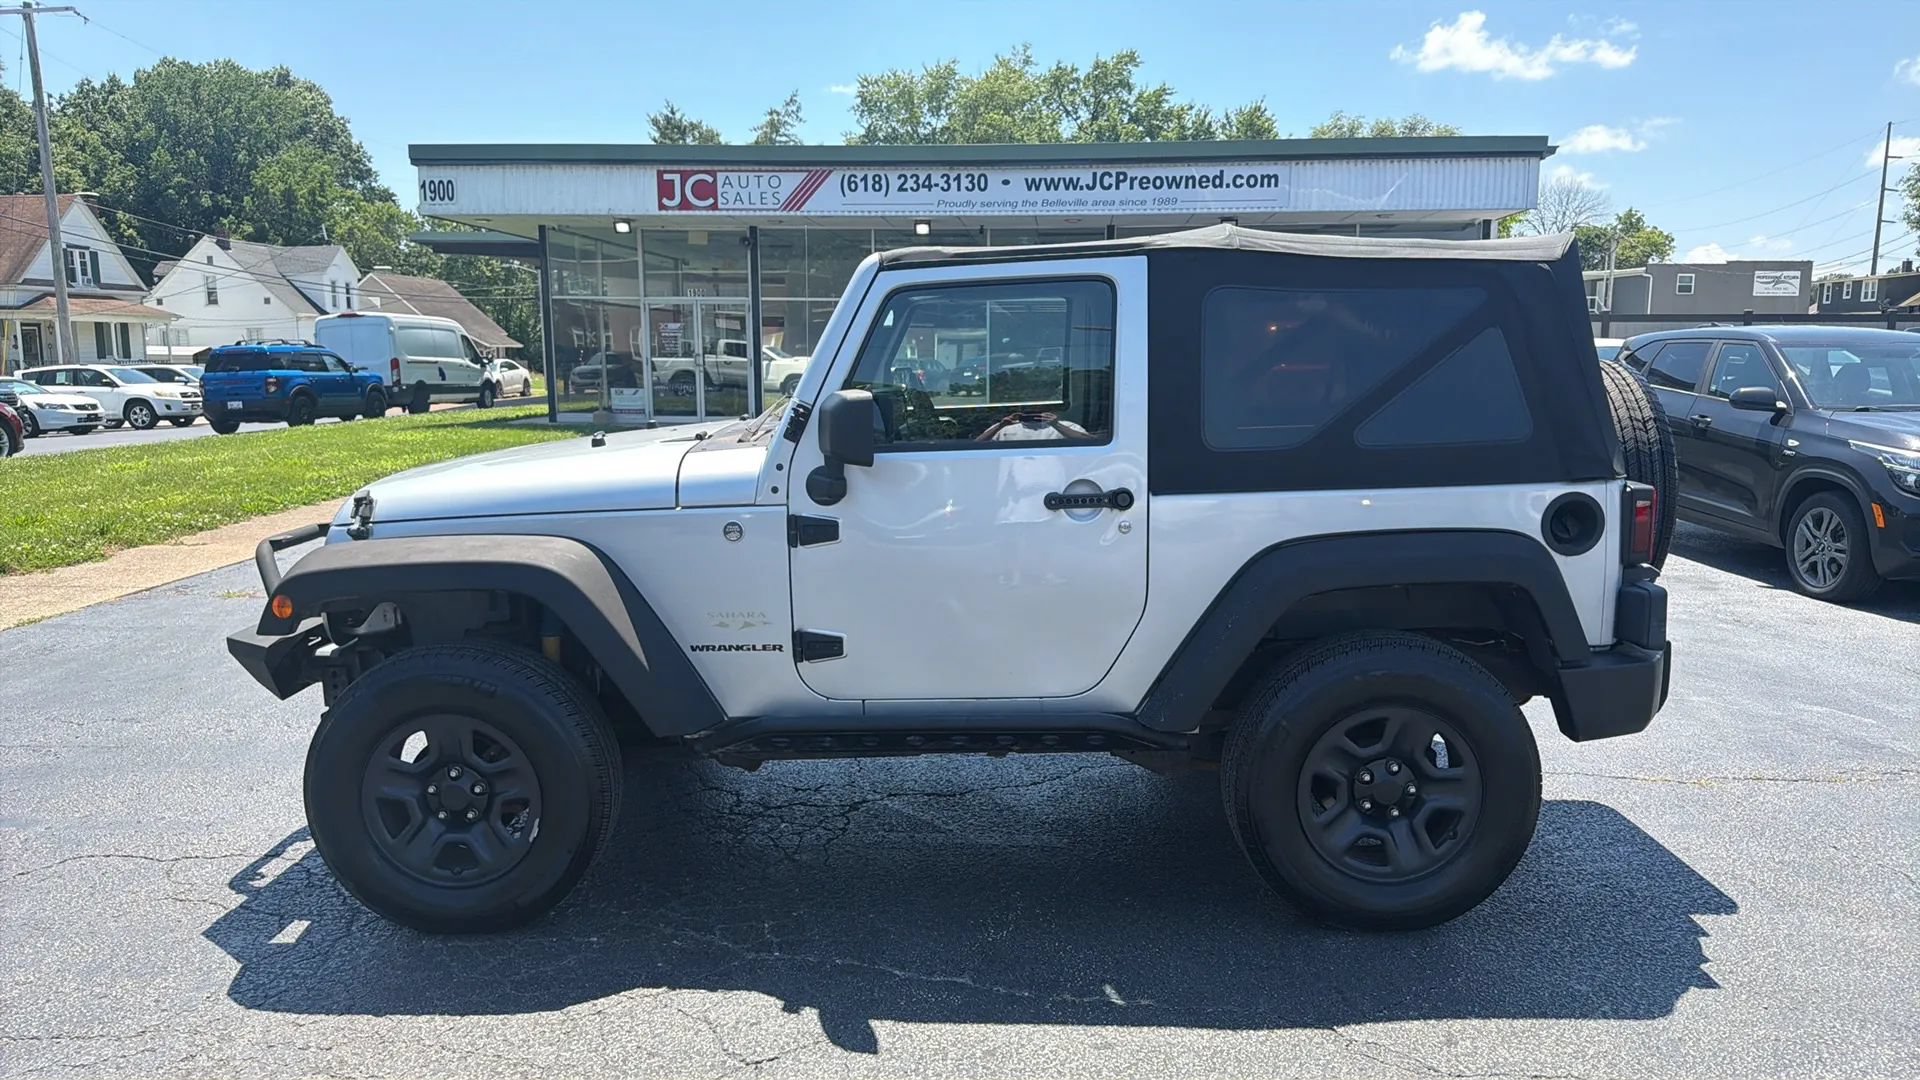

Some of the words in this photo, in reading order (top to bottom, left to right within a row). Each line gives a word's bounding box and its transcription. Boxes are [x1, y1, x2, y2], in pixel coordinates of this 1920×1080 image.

[721, 175, 782, 190] AUTO
[839, 173, 890, 198] (618)
[896, 172, 989, 193] 234-3130
[1024, 169, 1279, 191] www.JCPreowned.com
[420, 179, 455, 202] 1900
[661, 173, 715, 208] JC
[720, 191, 781, 206] SALES
[936, 199, 977, 210] Proudly
[979, 199, 1018, 210] serving
[1021, 199, 1038, 208] the
[1041, 198, 1089, 208] Belleville
[1091, 199, 1116, 208] area
[1118, 197, 1148, 207] since
[1151, 196, 1178, 207] 1989
[706, 611, 767, 619] SAHARA
[689, 643, 785, 652] WRANGLER
